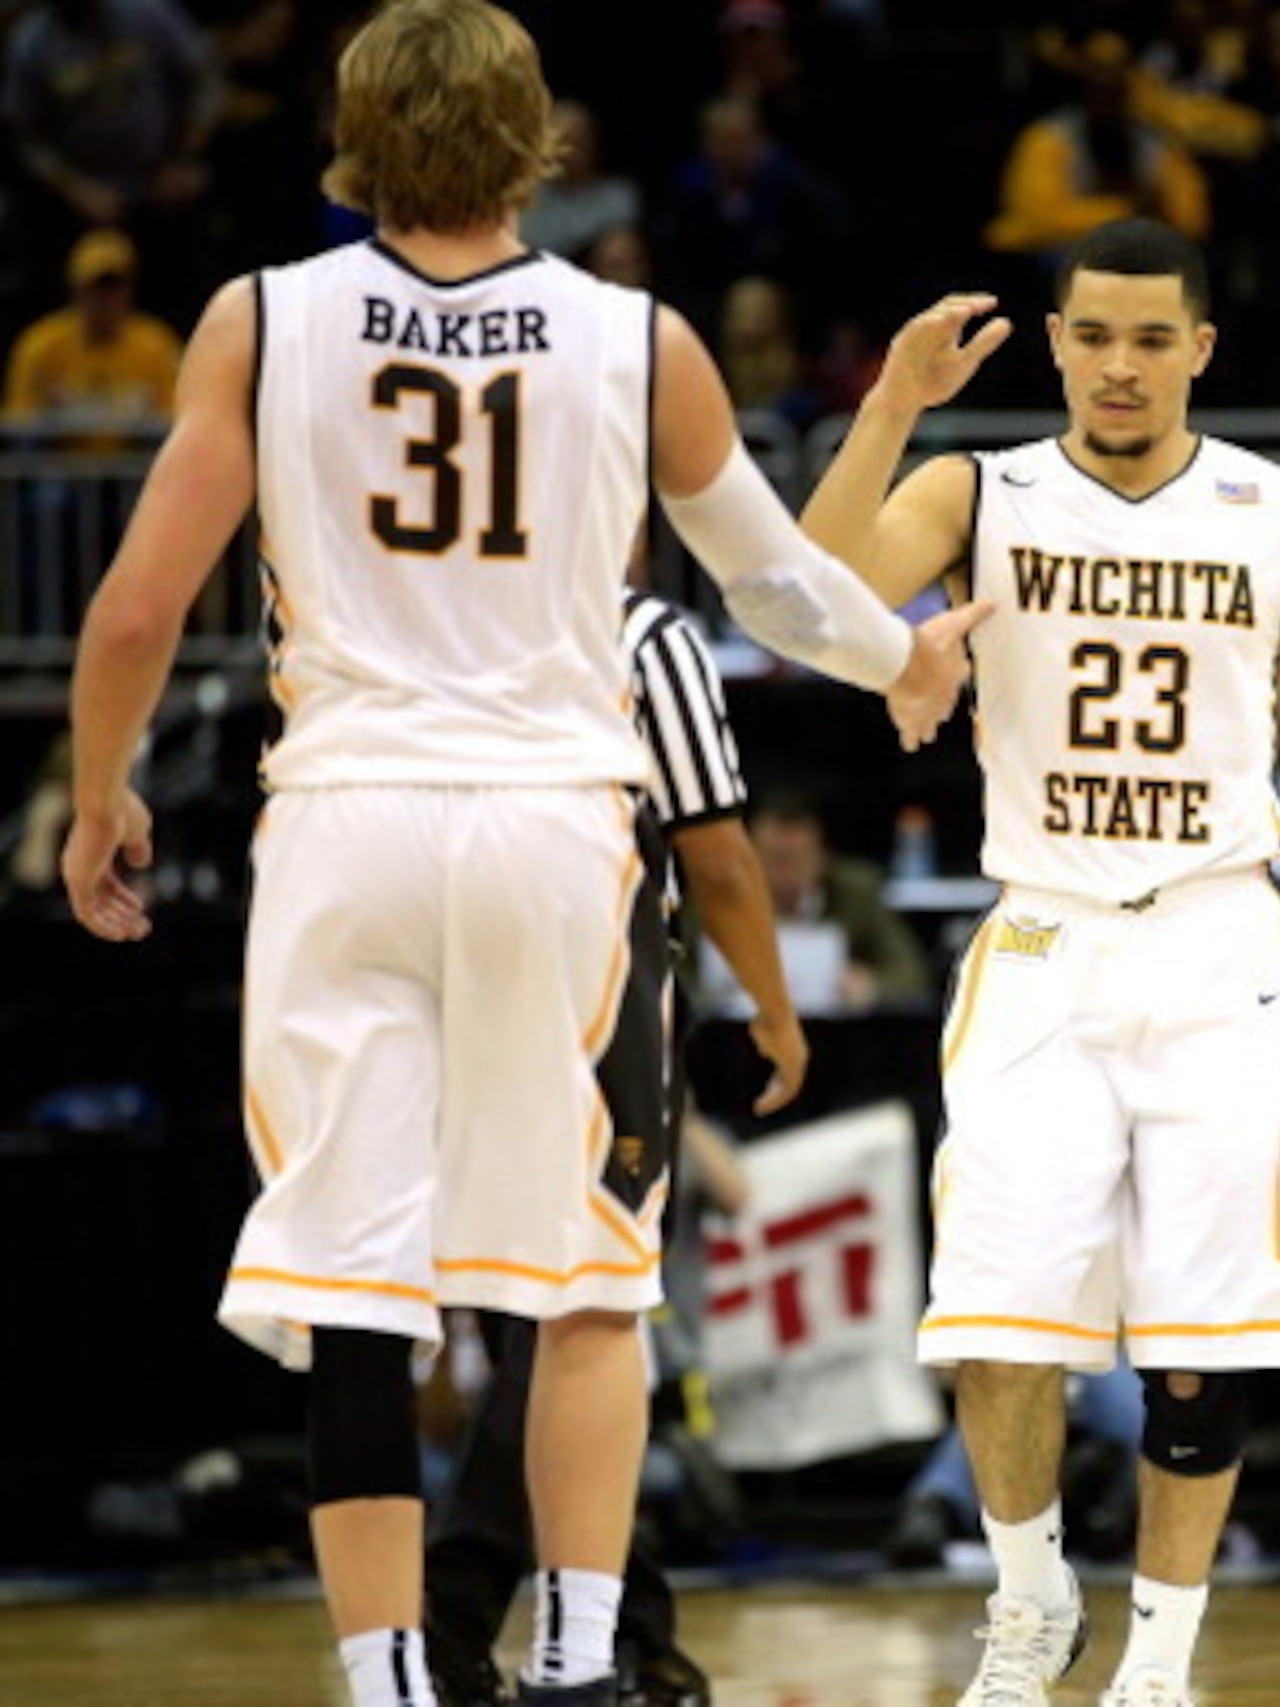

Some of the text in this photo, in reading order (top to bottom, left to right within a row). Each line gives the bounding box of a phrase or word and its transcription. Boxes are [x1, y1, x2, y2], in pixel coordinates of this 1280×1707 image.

[361, 296, 551, 357] BAKER
[369, 360, 529, 560] 31
[1008, 546, 1256, 629] WICHITA
[1068, 639, 1190, 754] 23
[1043, 772, 1211, 843] STATE
